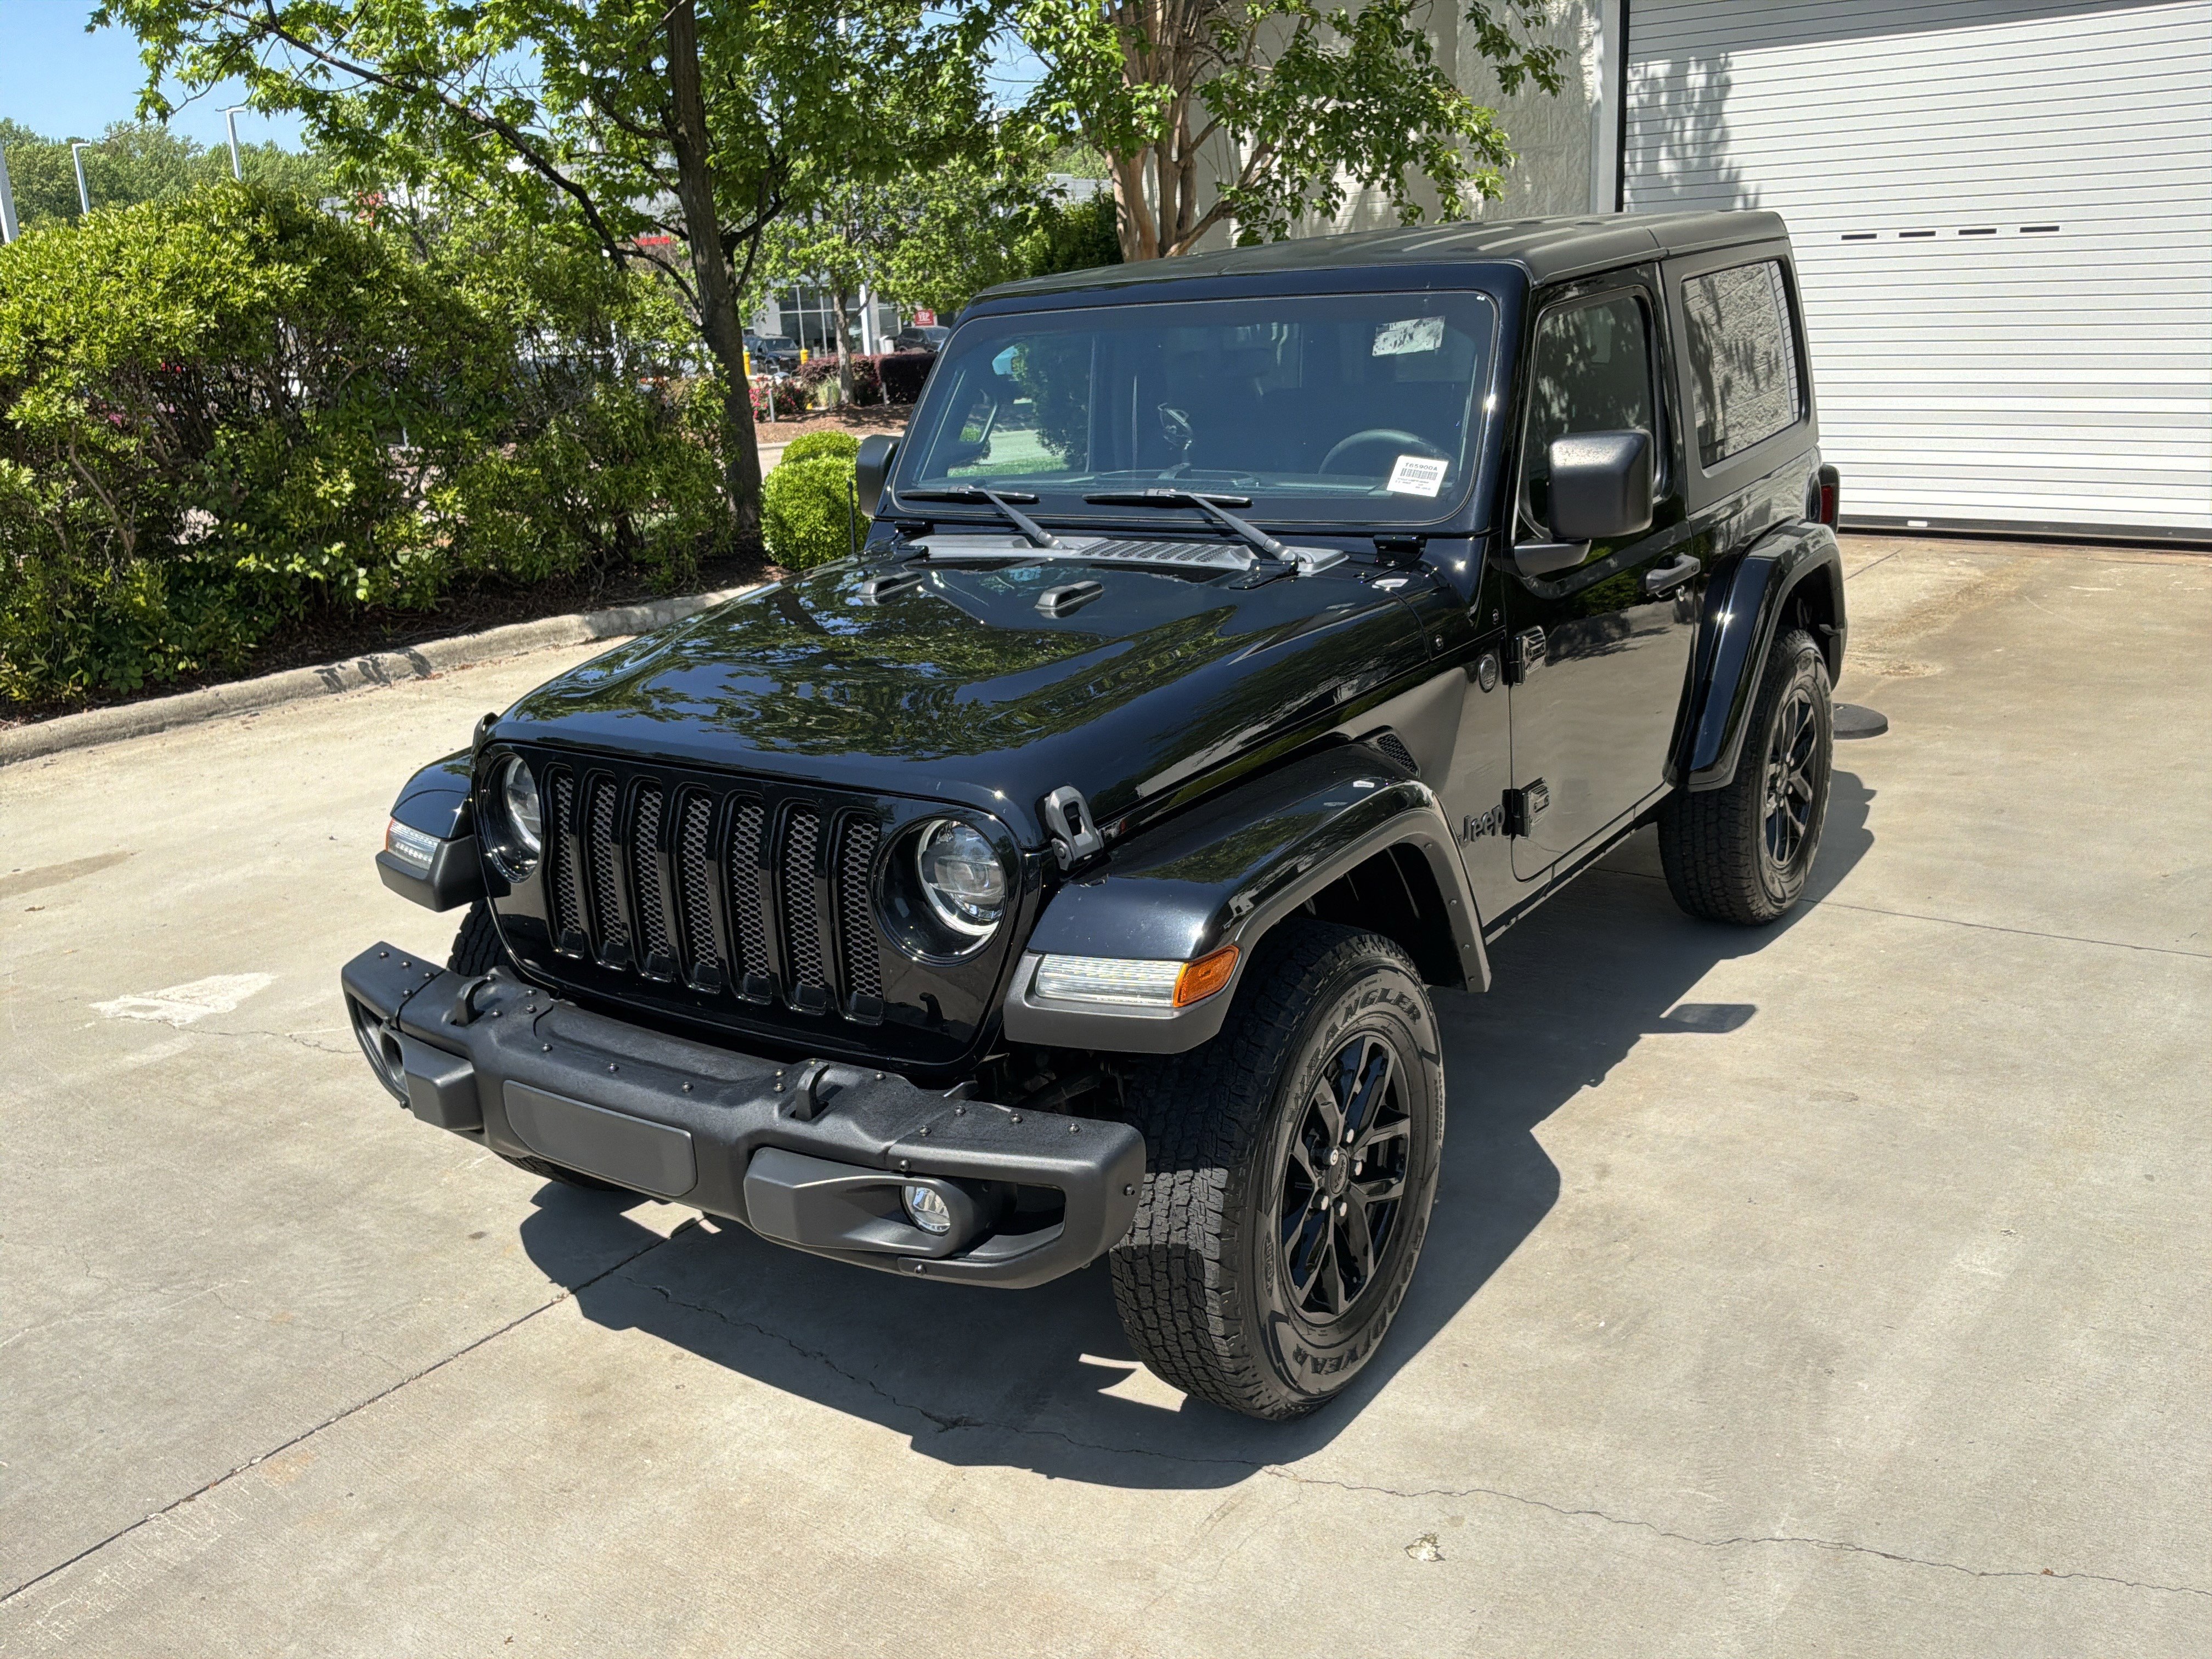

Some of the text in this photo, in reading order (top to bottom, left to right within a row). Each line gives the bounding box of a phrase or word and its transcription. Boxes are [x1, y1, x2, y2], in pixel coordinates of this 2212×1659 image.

[1457, 804, 1505, 849] Jeep
[1286, 988, 1421, 1122] WRANGLER
[1292, 1217, 1425, 1375] GOODYEAR
